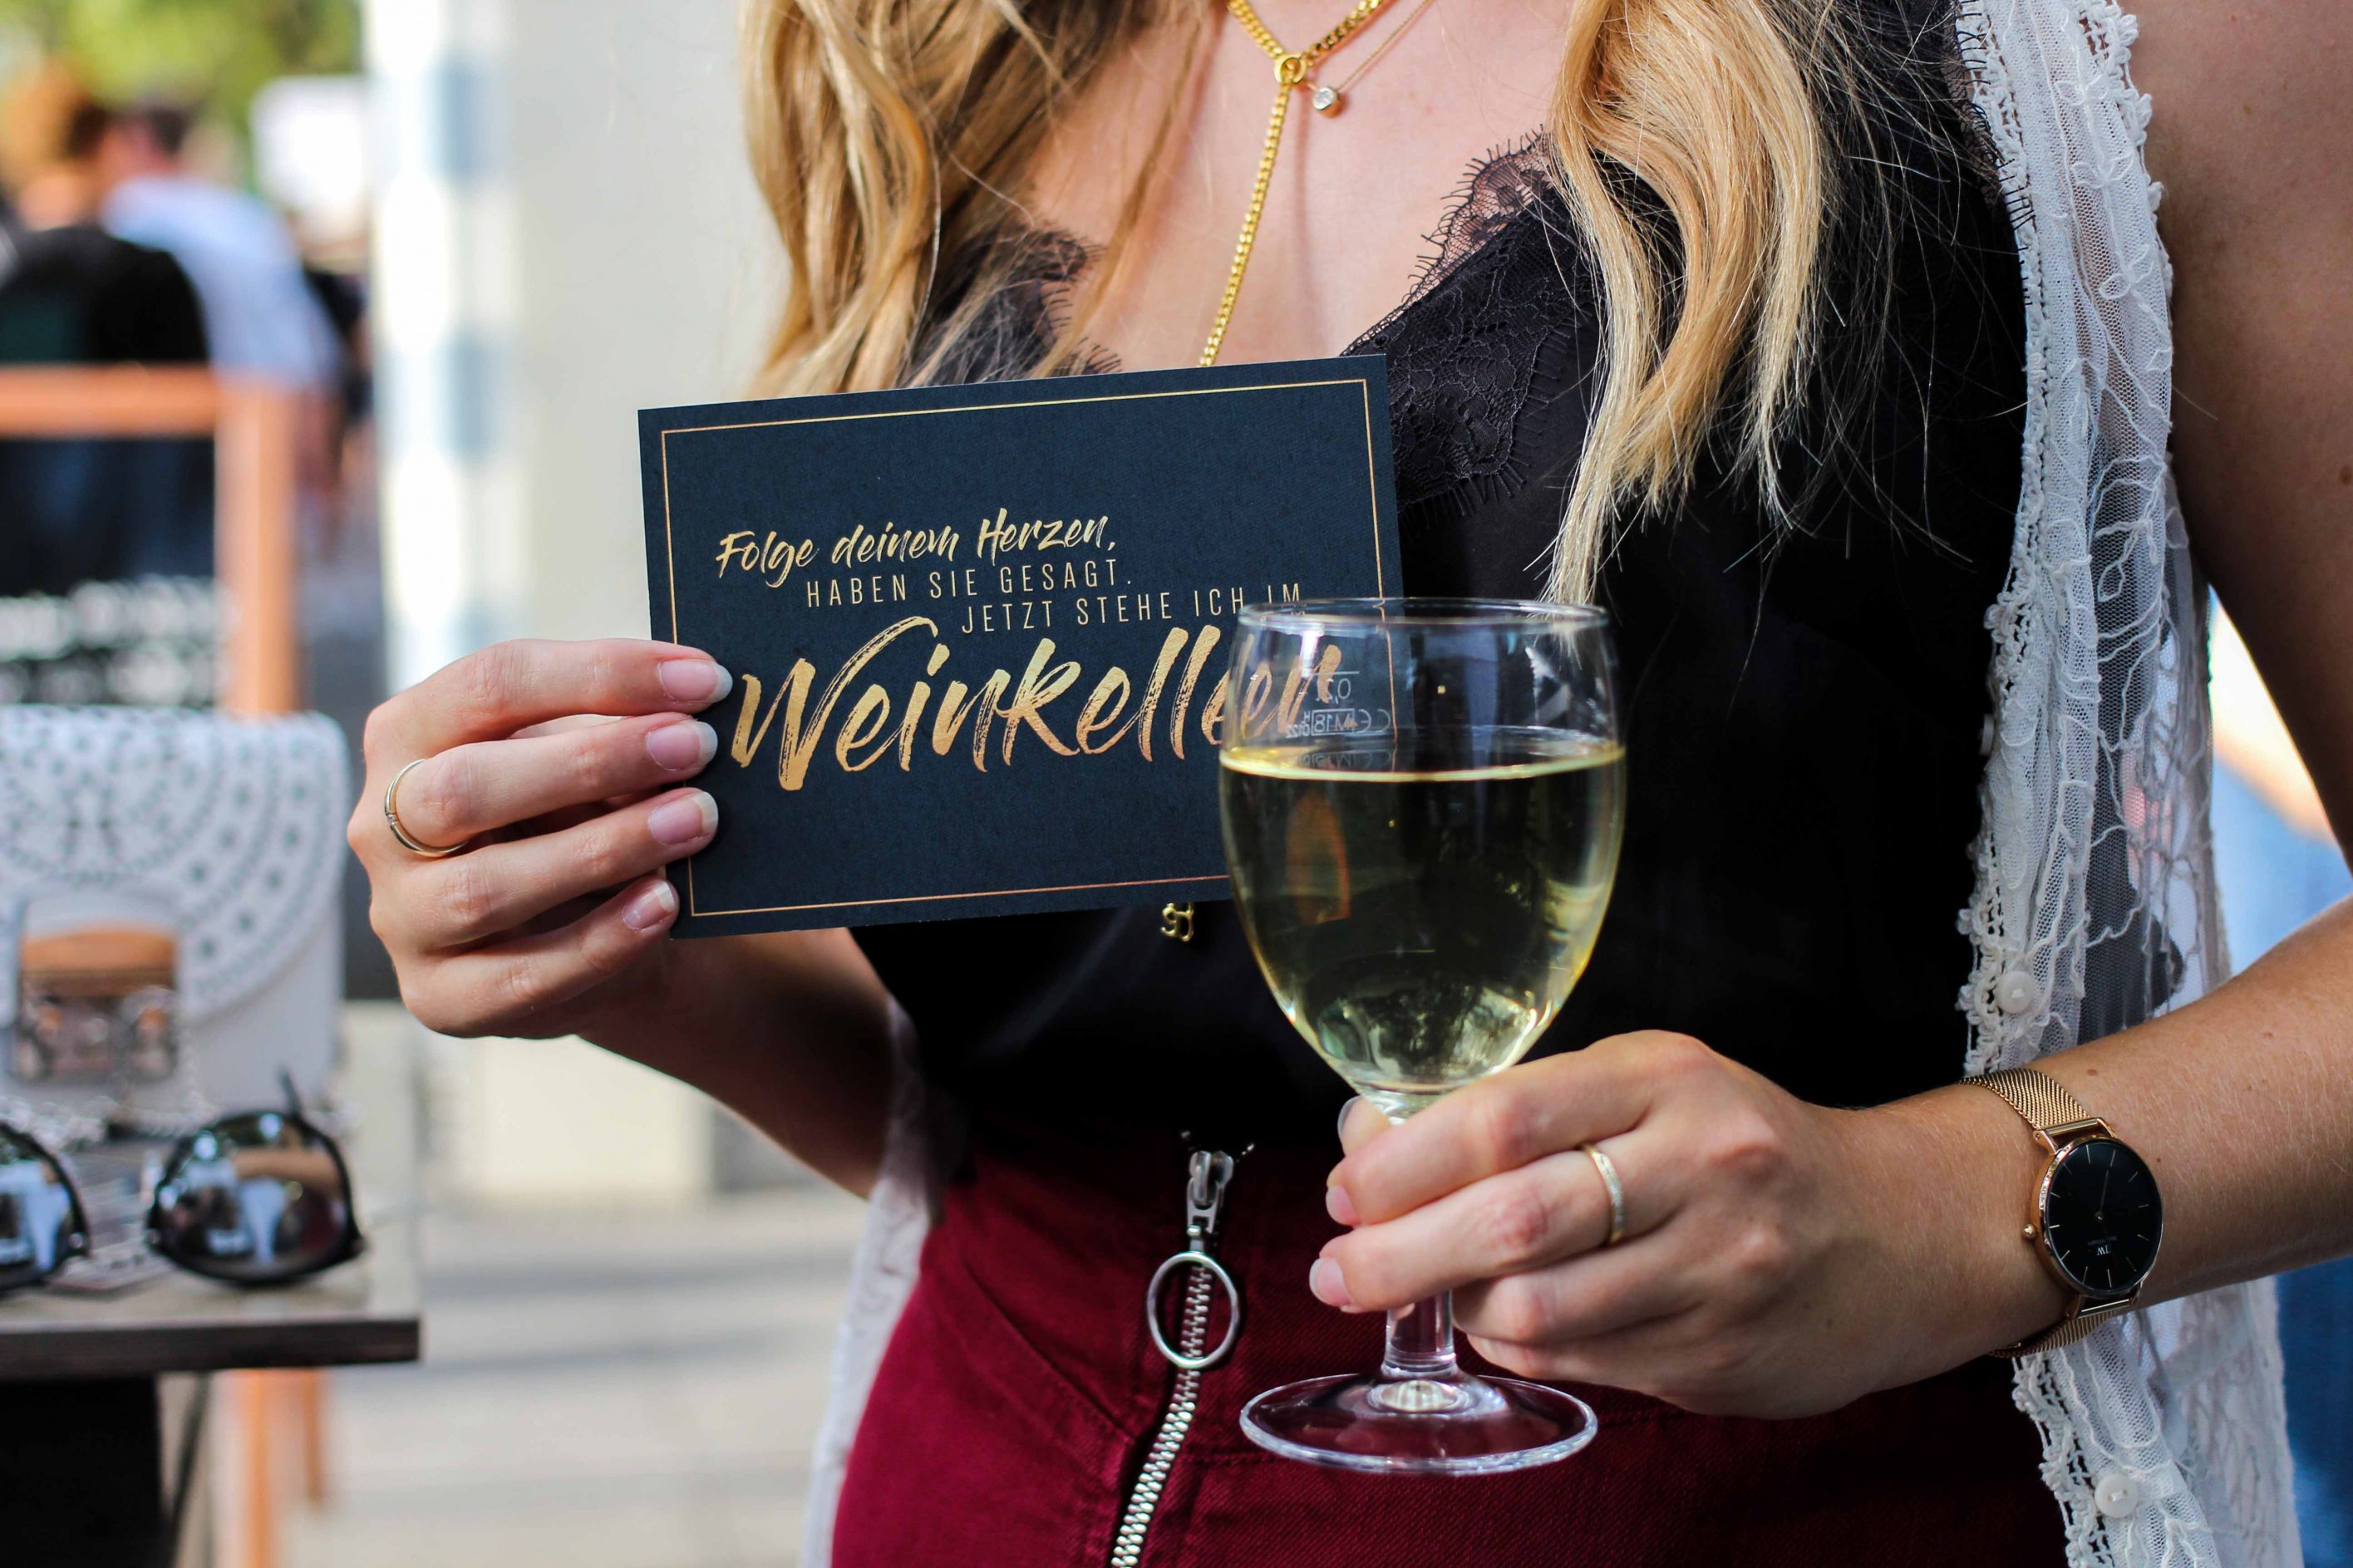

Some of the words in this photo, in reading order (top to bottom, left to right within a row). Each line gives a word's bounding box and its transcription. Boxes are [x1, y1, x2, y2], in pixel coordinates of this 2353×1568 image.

[715, 530, 819, 589] Folge
[831, 522, 959, 568] deinem
[977, 508, 1116, 567] Herzen,
[806, 574, 907, 607] HABEN
[928, 568, 977, 598] SIE
[1000, 559, 1131, 594] GESAGT.
[962, 600, 1054, 634] JETZT
[1076, 592, 1172, 626] STEHE
[1194, 587, 1245, 617] ICH
[1267, 582, 1300, 606] IM
[731, 616, 1342, 792] Weinkeller
